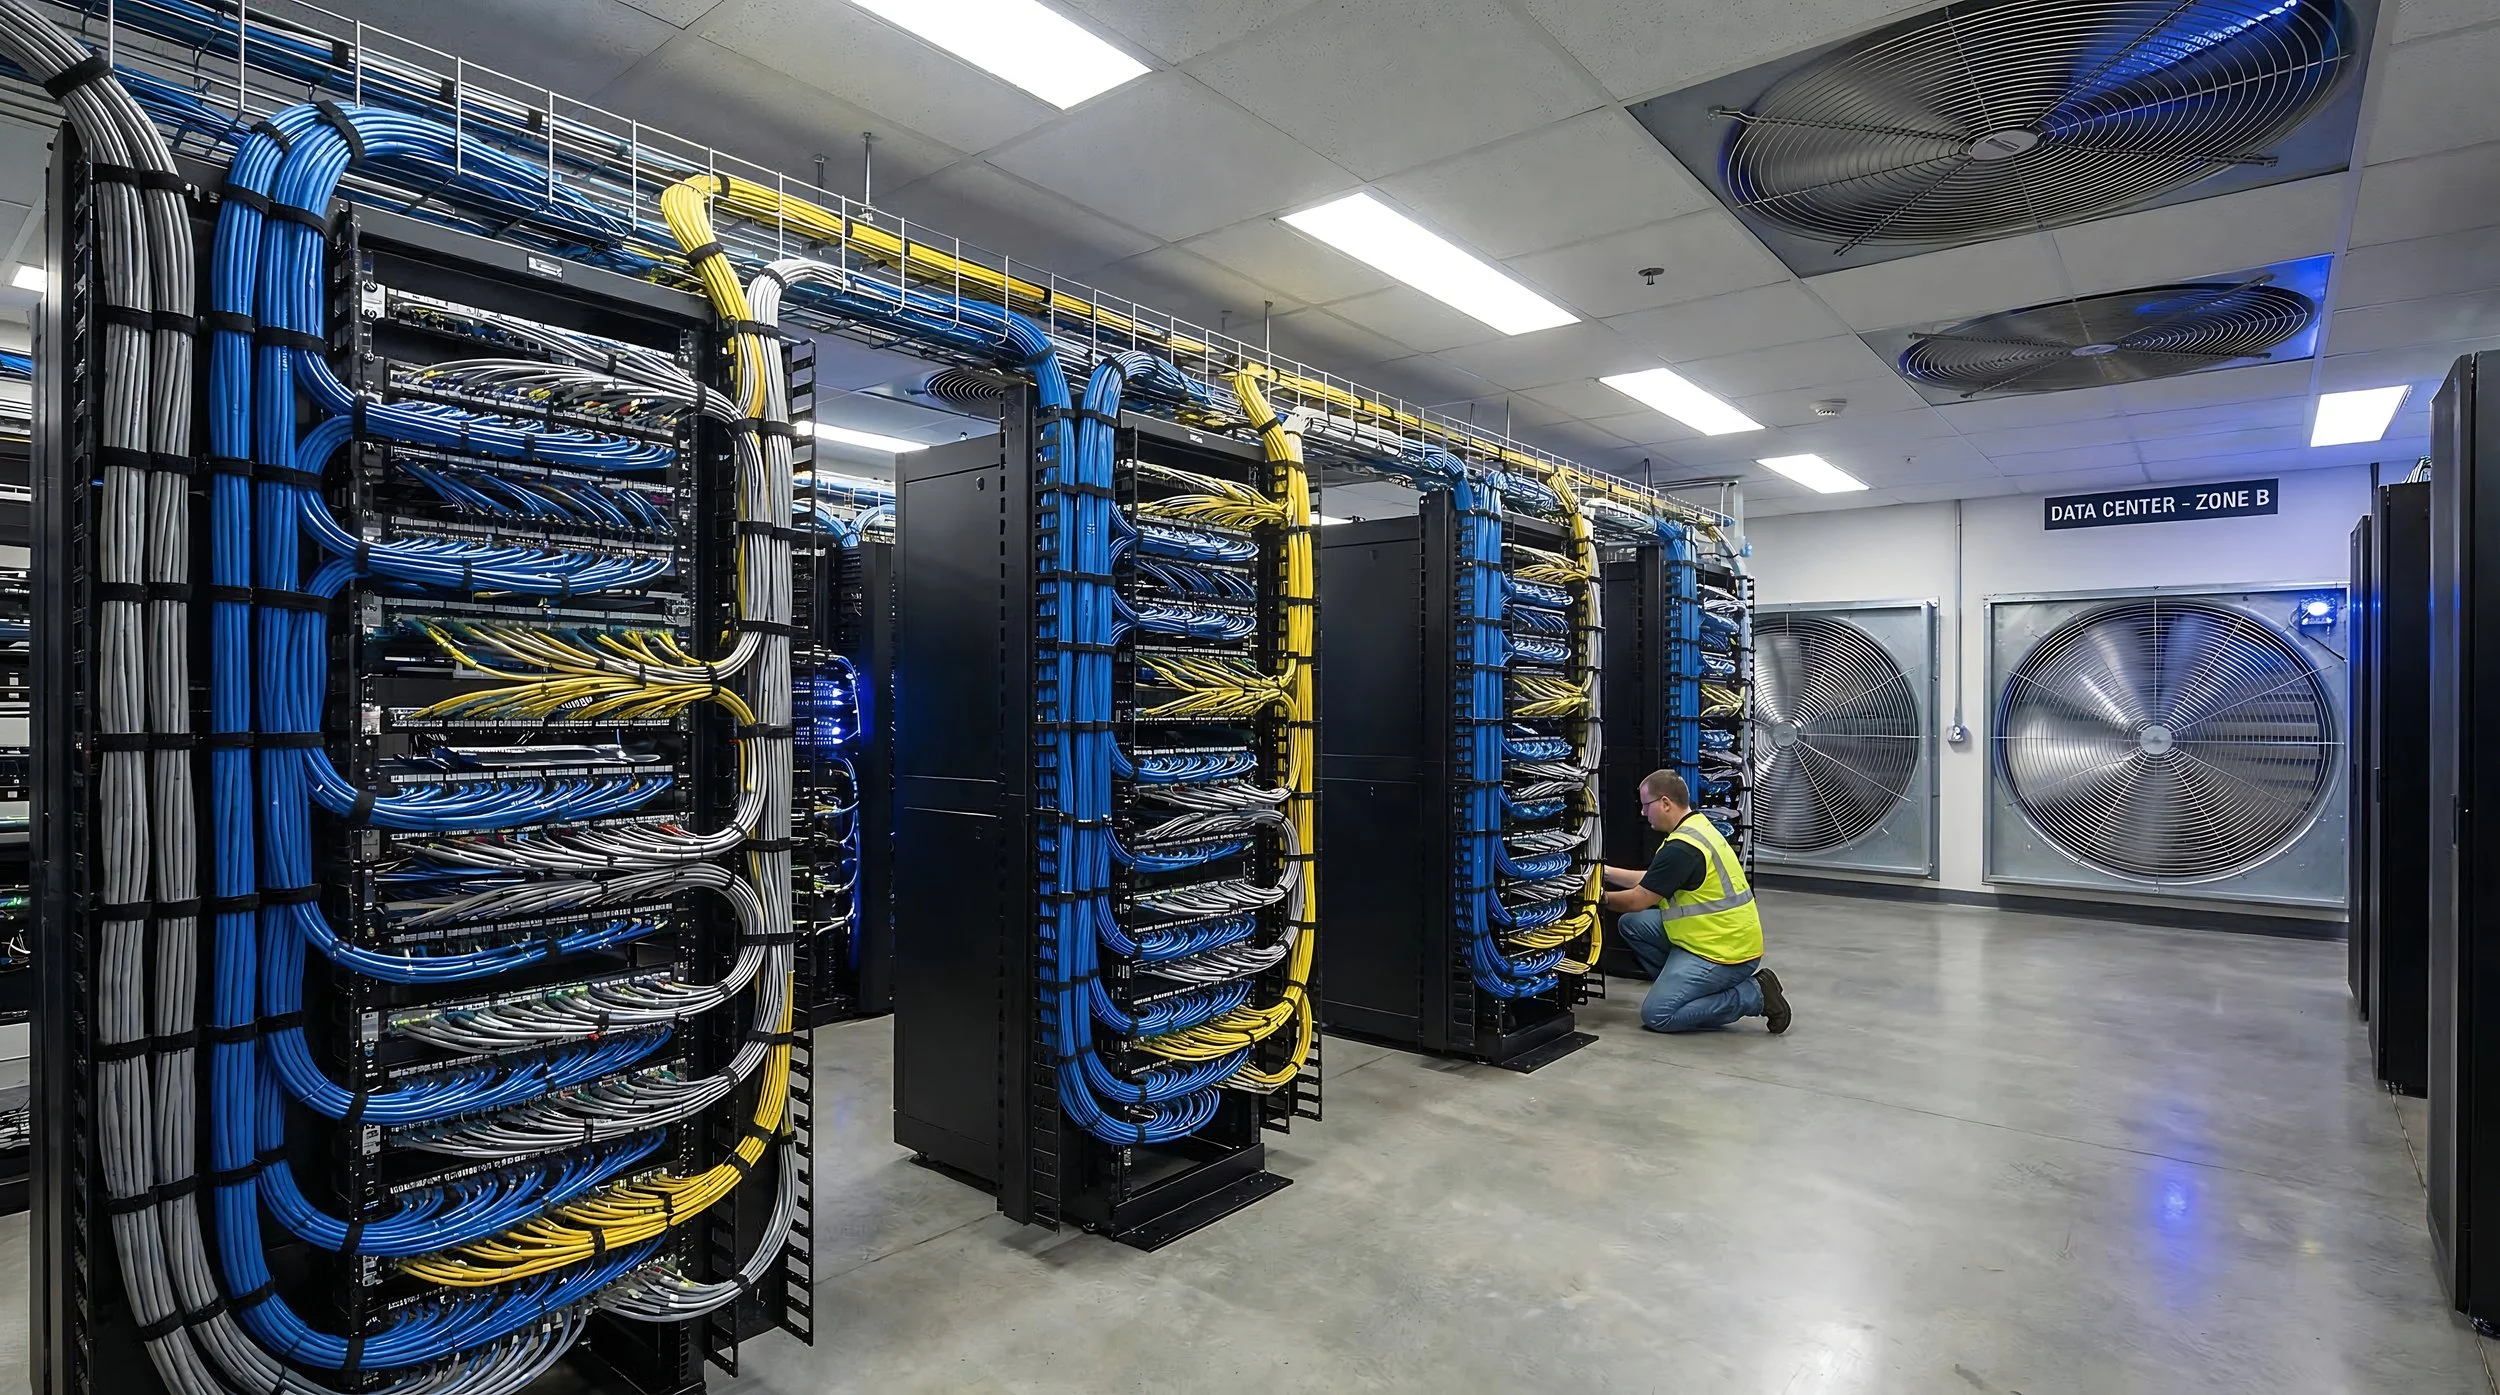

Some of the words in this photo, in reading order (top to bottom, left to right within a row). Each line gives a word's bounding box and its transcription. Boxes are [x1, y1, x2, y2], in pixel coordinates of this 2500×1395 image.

[2051, 503, 2096, 522] DATA
[2102, 496, 2176, 518] CENTER
[2196, 490, 2249, 511] ZONE
[2256, 489, 2270, 506] B
